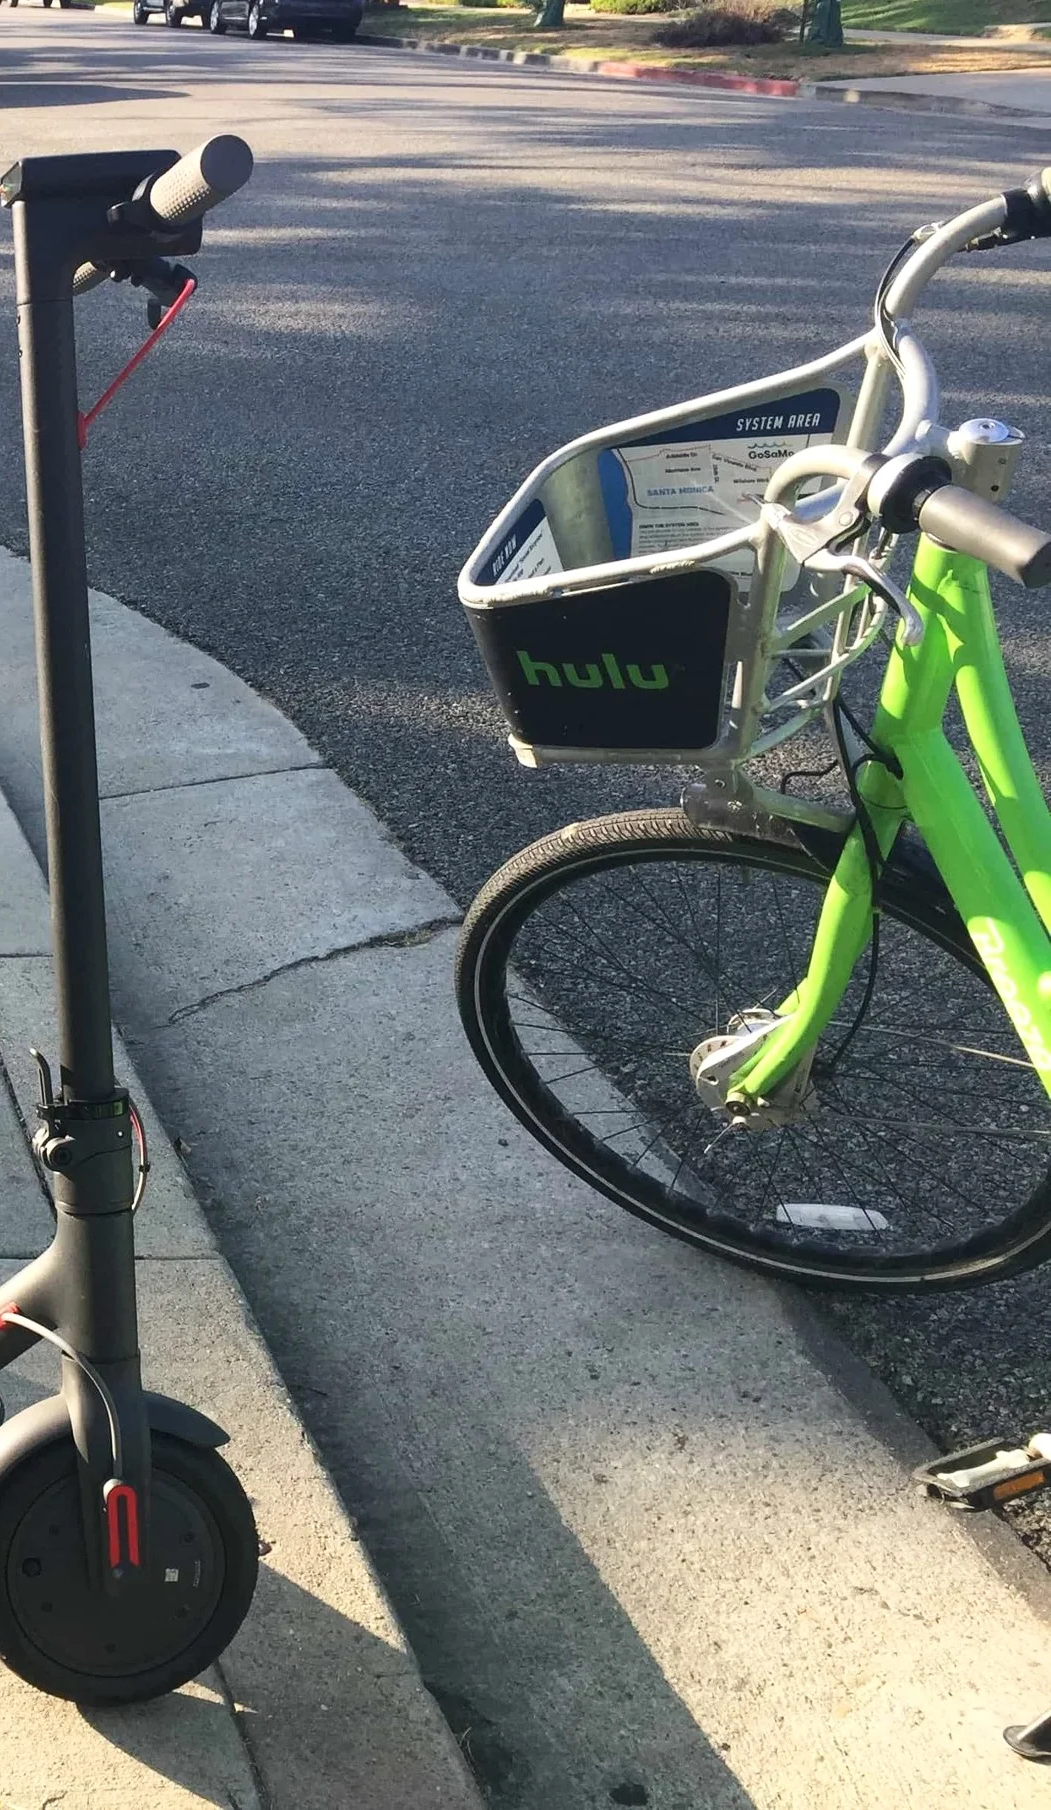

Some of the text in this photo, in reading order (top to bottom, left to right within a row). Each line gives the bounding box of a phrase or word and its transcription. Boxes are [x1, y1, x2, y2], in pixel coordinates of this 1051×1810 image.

[736, 413, 821, 432] SYSTEM AREA
[748, 449, 795, 459] GoSaMo
[647, 485, 715, 497] SANTA MONICA
[516, 650, 669, 690] hulu
